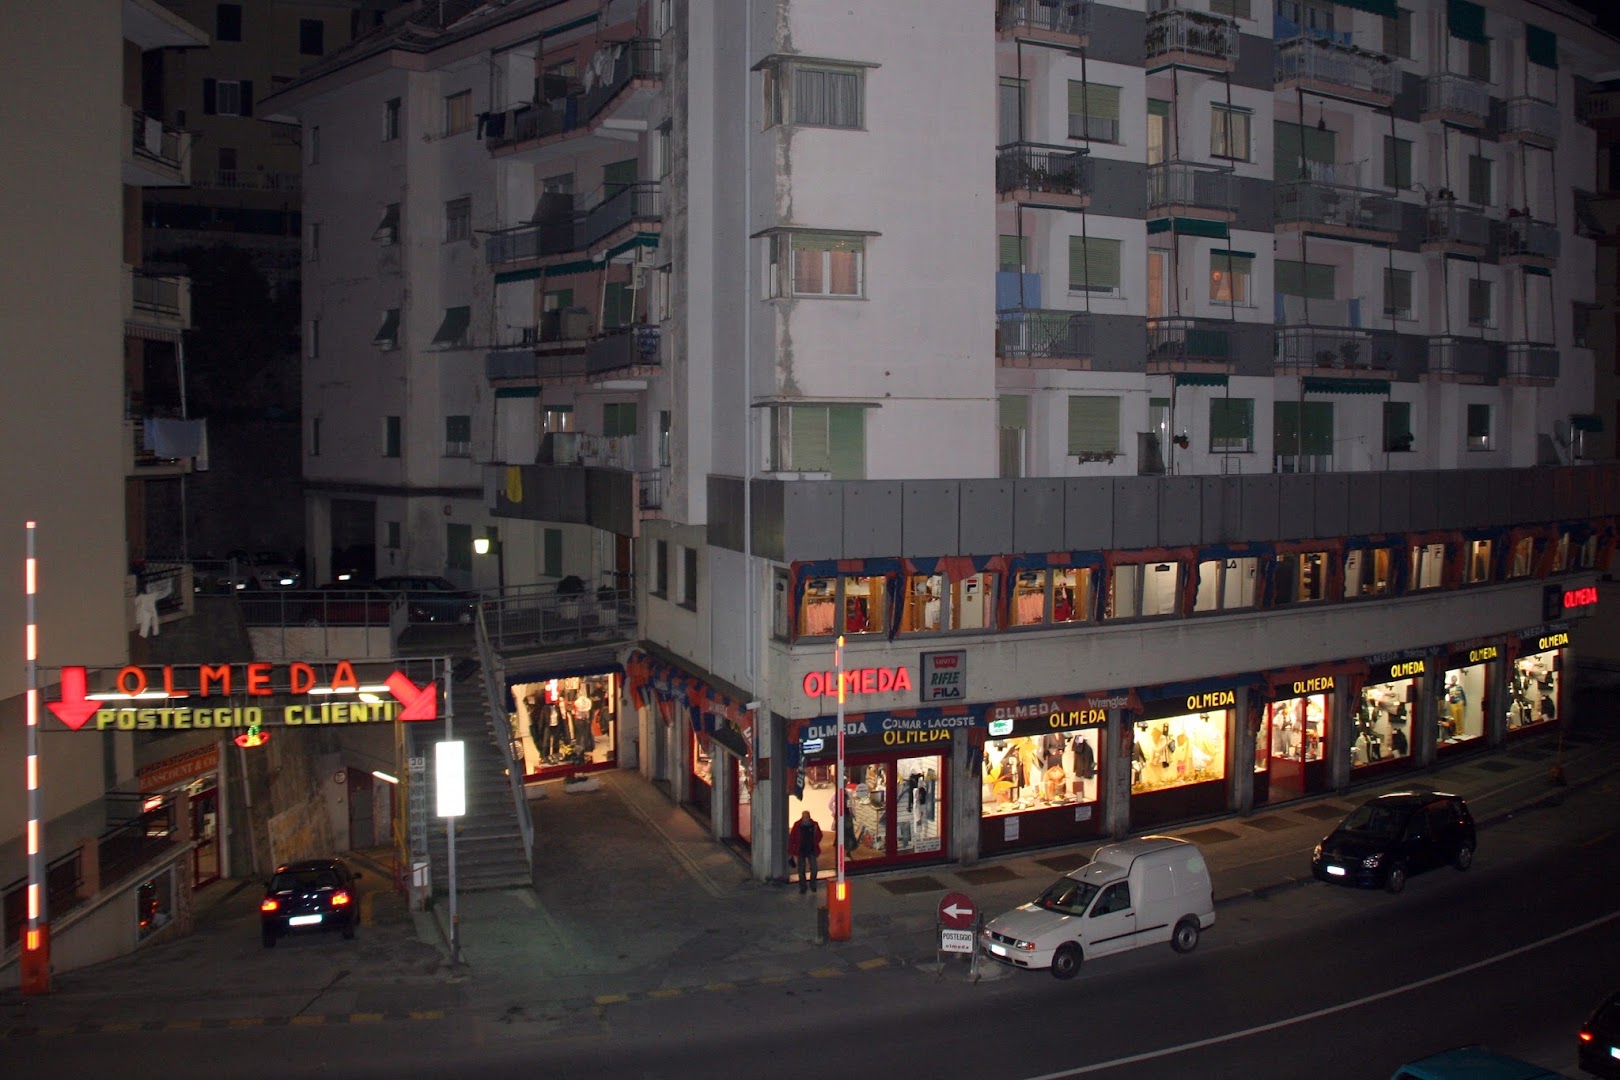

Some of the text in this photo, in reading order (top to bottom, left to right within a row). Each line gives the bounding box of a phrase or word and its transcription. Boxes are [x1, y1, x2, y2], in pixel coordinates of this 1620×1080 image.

[1562, 586, 1599, 608] OLMEDA
[1538, 632, 1569, 650] OLMEDA
[1469, 646, 1499, 663] OLMEDA
[115, 659, 360, 698] OLMEDA
[931, 671, 960, 685] RIFLE
[1391, 660, 1426, 679] OLMEDA
[803, 666, 912, 698] OLMEDA
[1293, 676, 1335, 694] OLMEDA
[933, 687, 960, 698] FILA
[1186, 690, 1235, 710] OLMEDA
[995, 701, 1060, 719] OLMEDA
[1088, 696, 1129, 709] Wrangler
[96, 700, 396, 730] POSTEGGIO CLIENTI
[928, 716, 976, 728] LACOSTE
[1049, 709, 1107, 728] OLMEDA
[883, 730, 951, 746] OLMEDA
[943, 932, 971, 941] POSTEGGIO
